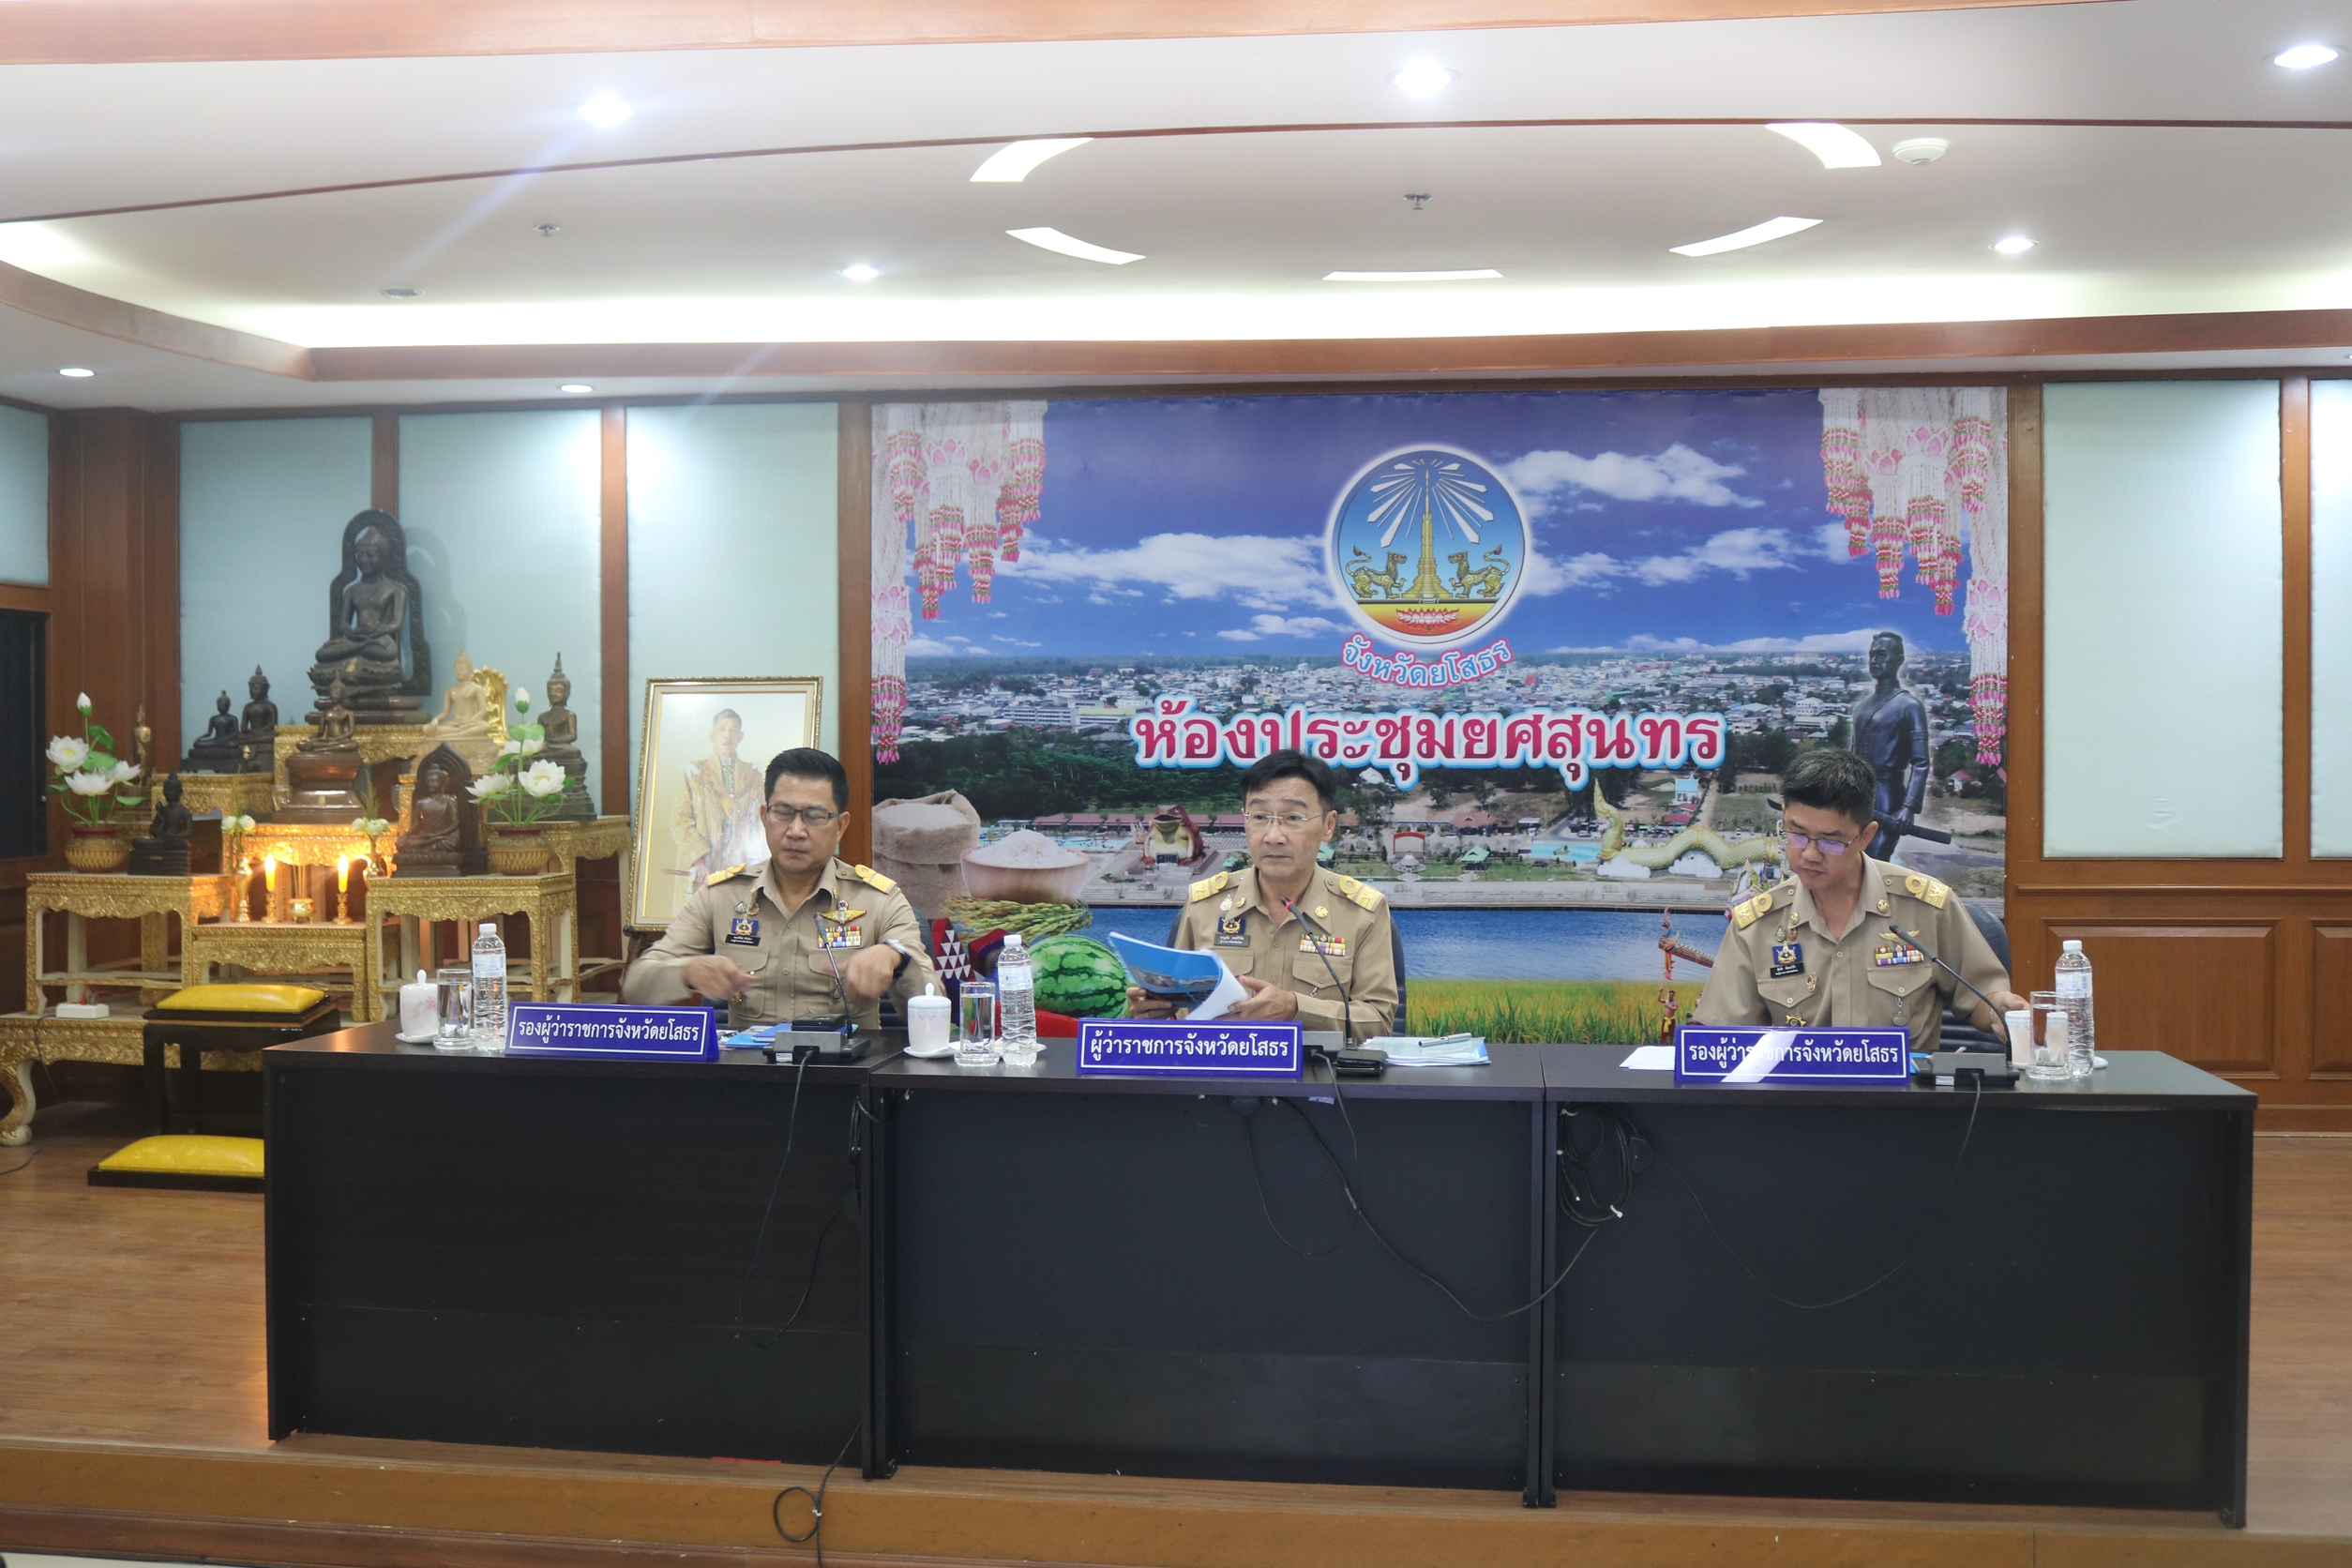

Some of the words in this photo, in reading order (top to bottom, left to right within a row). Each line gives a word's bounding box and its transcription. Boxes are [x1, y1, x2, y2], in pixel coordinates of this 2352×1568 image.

[1345, 636, 1511, 686] จังหวัดยโสธร
[1136, 701, 1720, 781] ห้องประชุมยศสุนทร
[518, 1015, 700, 1045] รองผู้ว่าราชการจังหวัดยโสธร
[1090, 1030, 1289, 1062] ผู้ว่าราชการจังหวัดยโสธร
